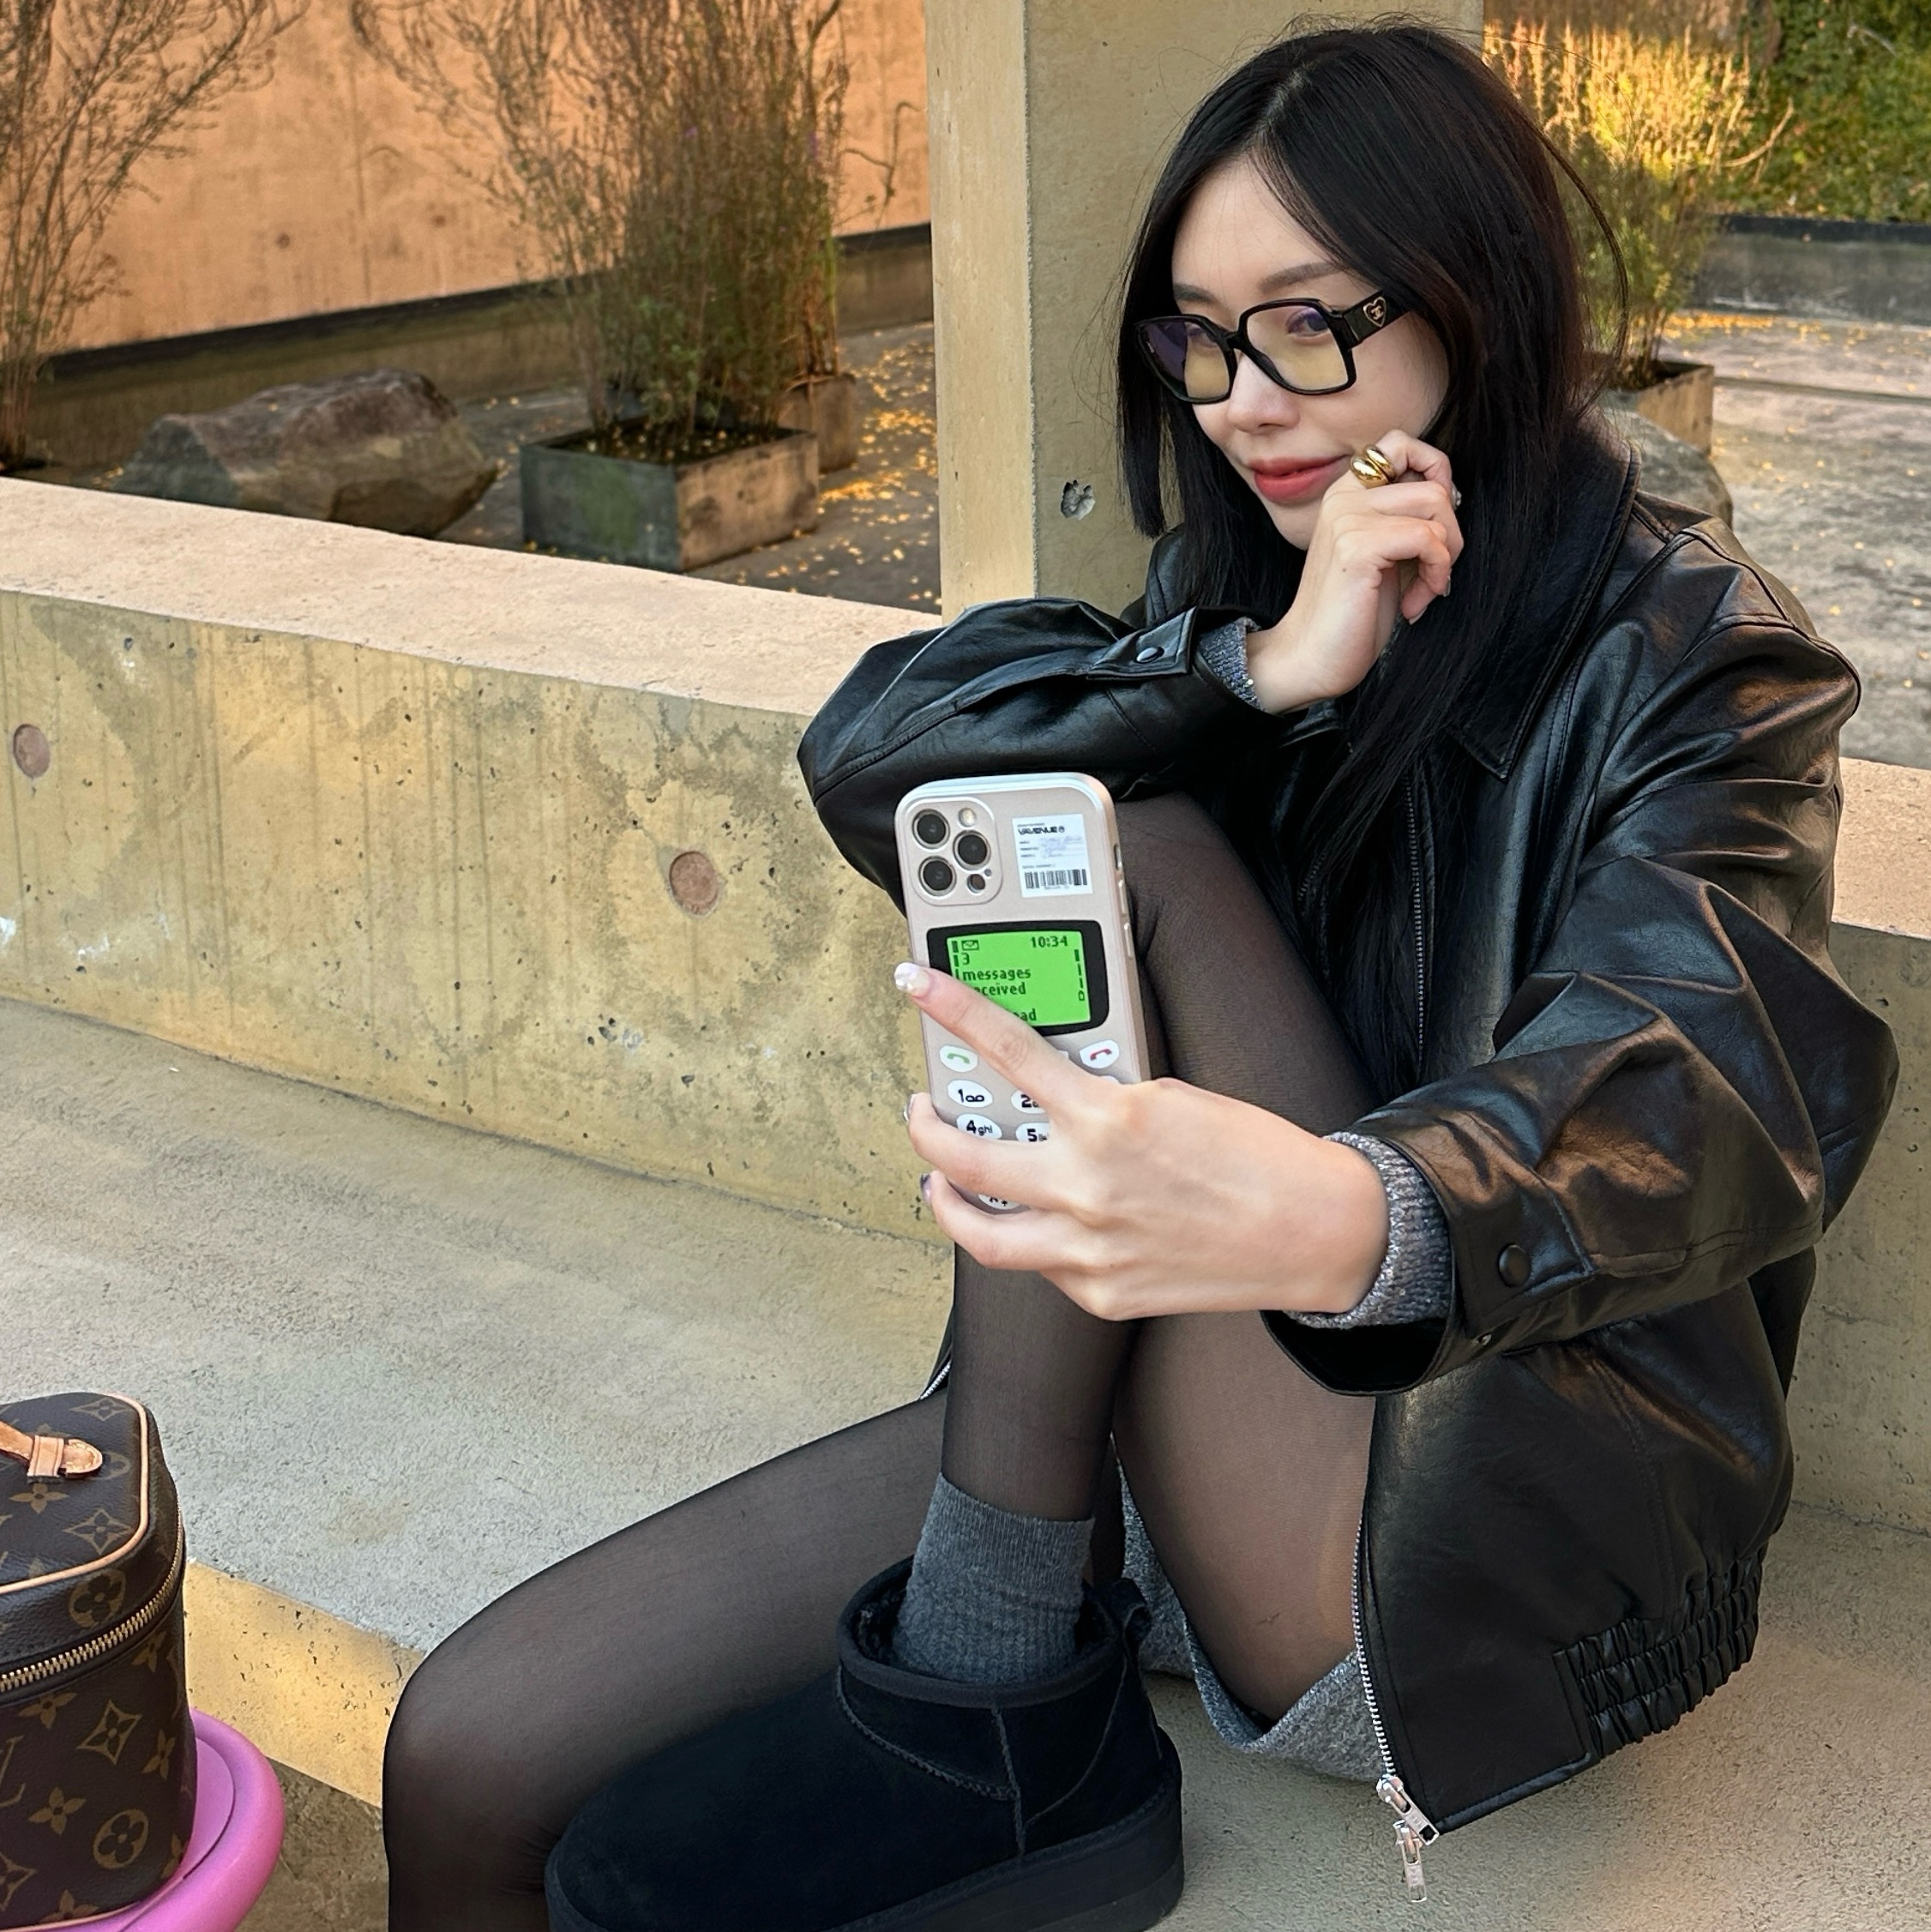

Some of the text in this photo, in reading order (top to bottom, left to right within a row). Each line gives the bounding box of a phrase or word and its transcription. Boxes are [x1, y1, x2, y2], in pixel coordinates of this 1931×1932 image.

[1031, 936, 1068, 948] 10:34
[961, 952, 971, 966] 3
[963, 968, 1032, 981] messages
[973, 982, 1026, 996] ceived
